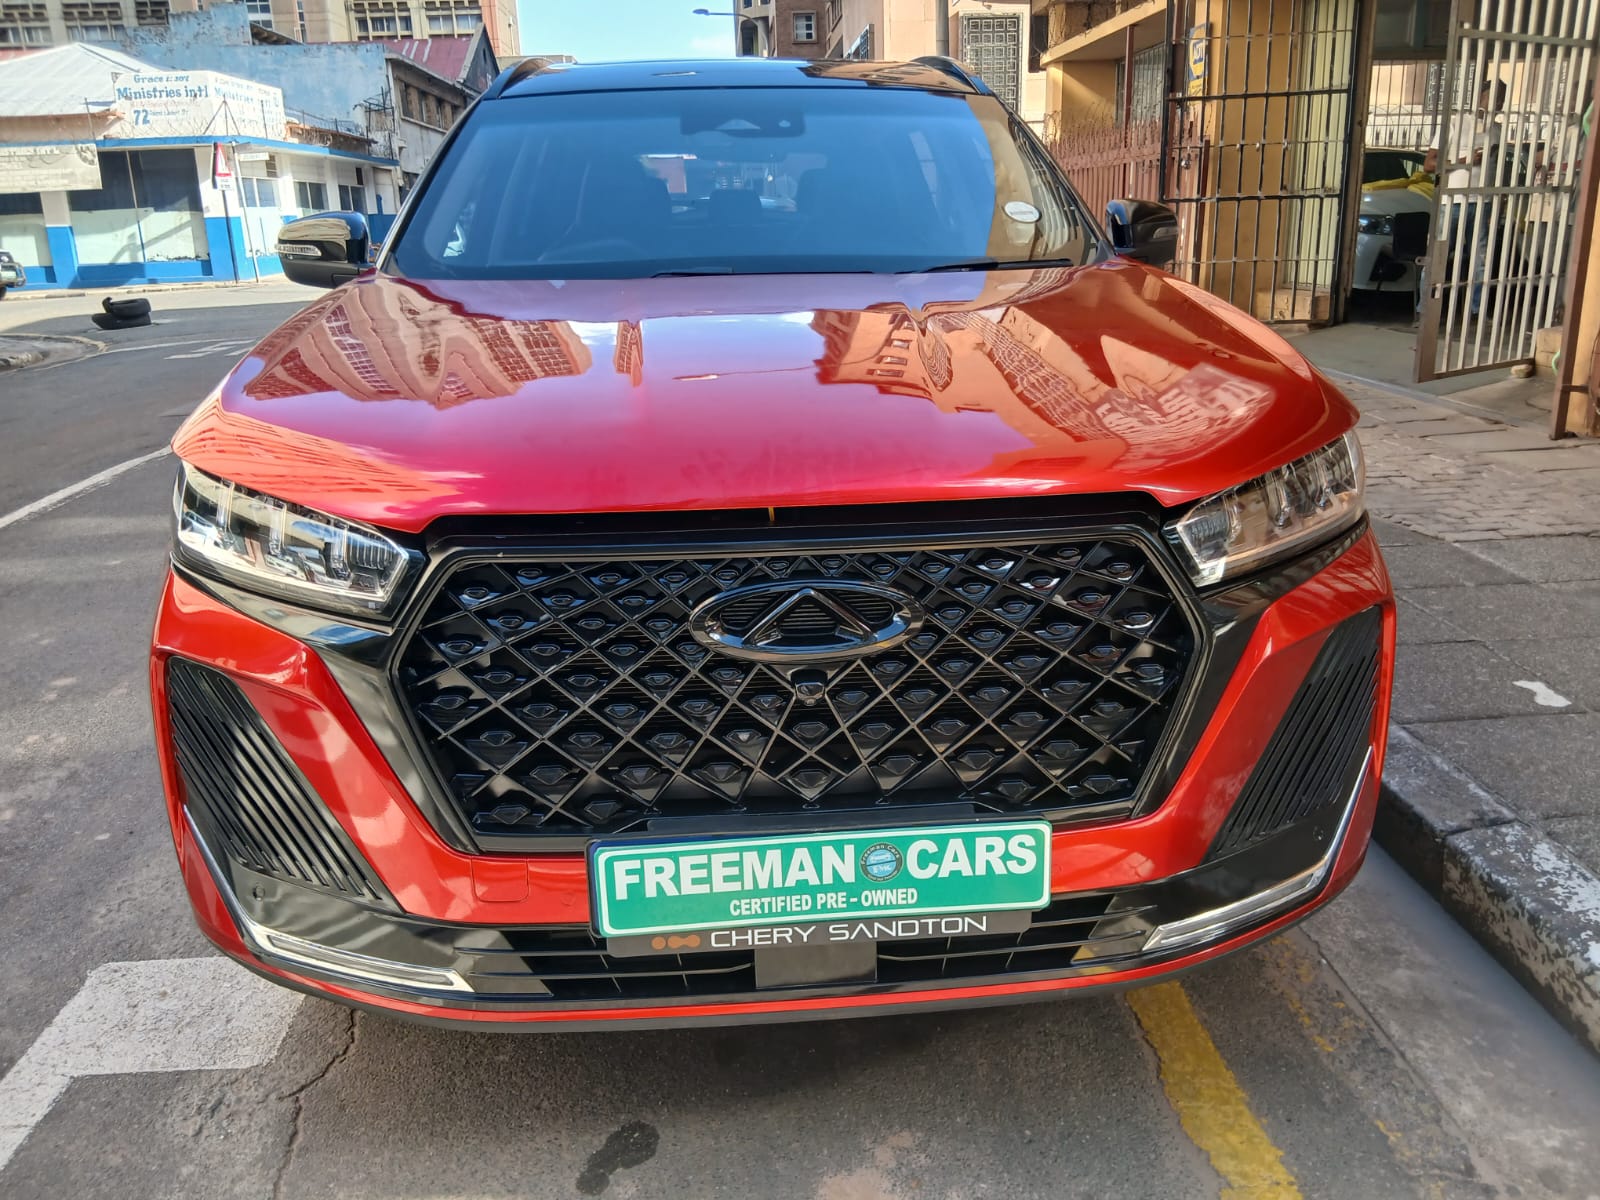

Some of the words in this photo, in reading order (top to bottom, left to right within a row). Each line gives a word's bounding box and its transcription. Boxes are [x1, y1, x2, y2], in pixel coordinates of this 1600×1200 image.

[133, 74, 164, 84] Grace
[116, 85, 182, 101] Ministries
[133, 108, 151, 126] 72
[613, 844, 856, 900] FREEMAN
[906, 834, 1038, 880] CARS
[729, 893, 812, 917] CERTIFIED
[710, 925, 817, 948] CHERY
[829, 916, 987, 942] SANDTON
